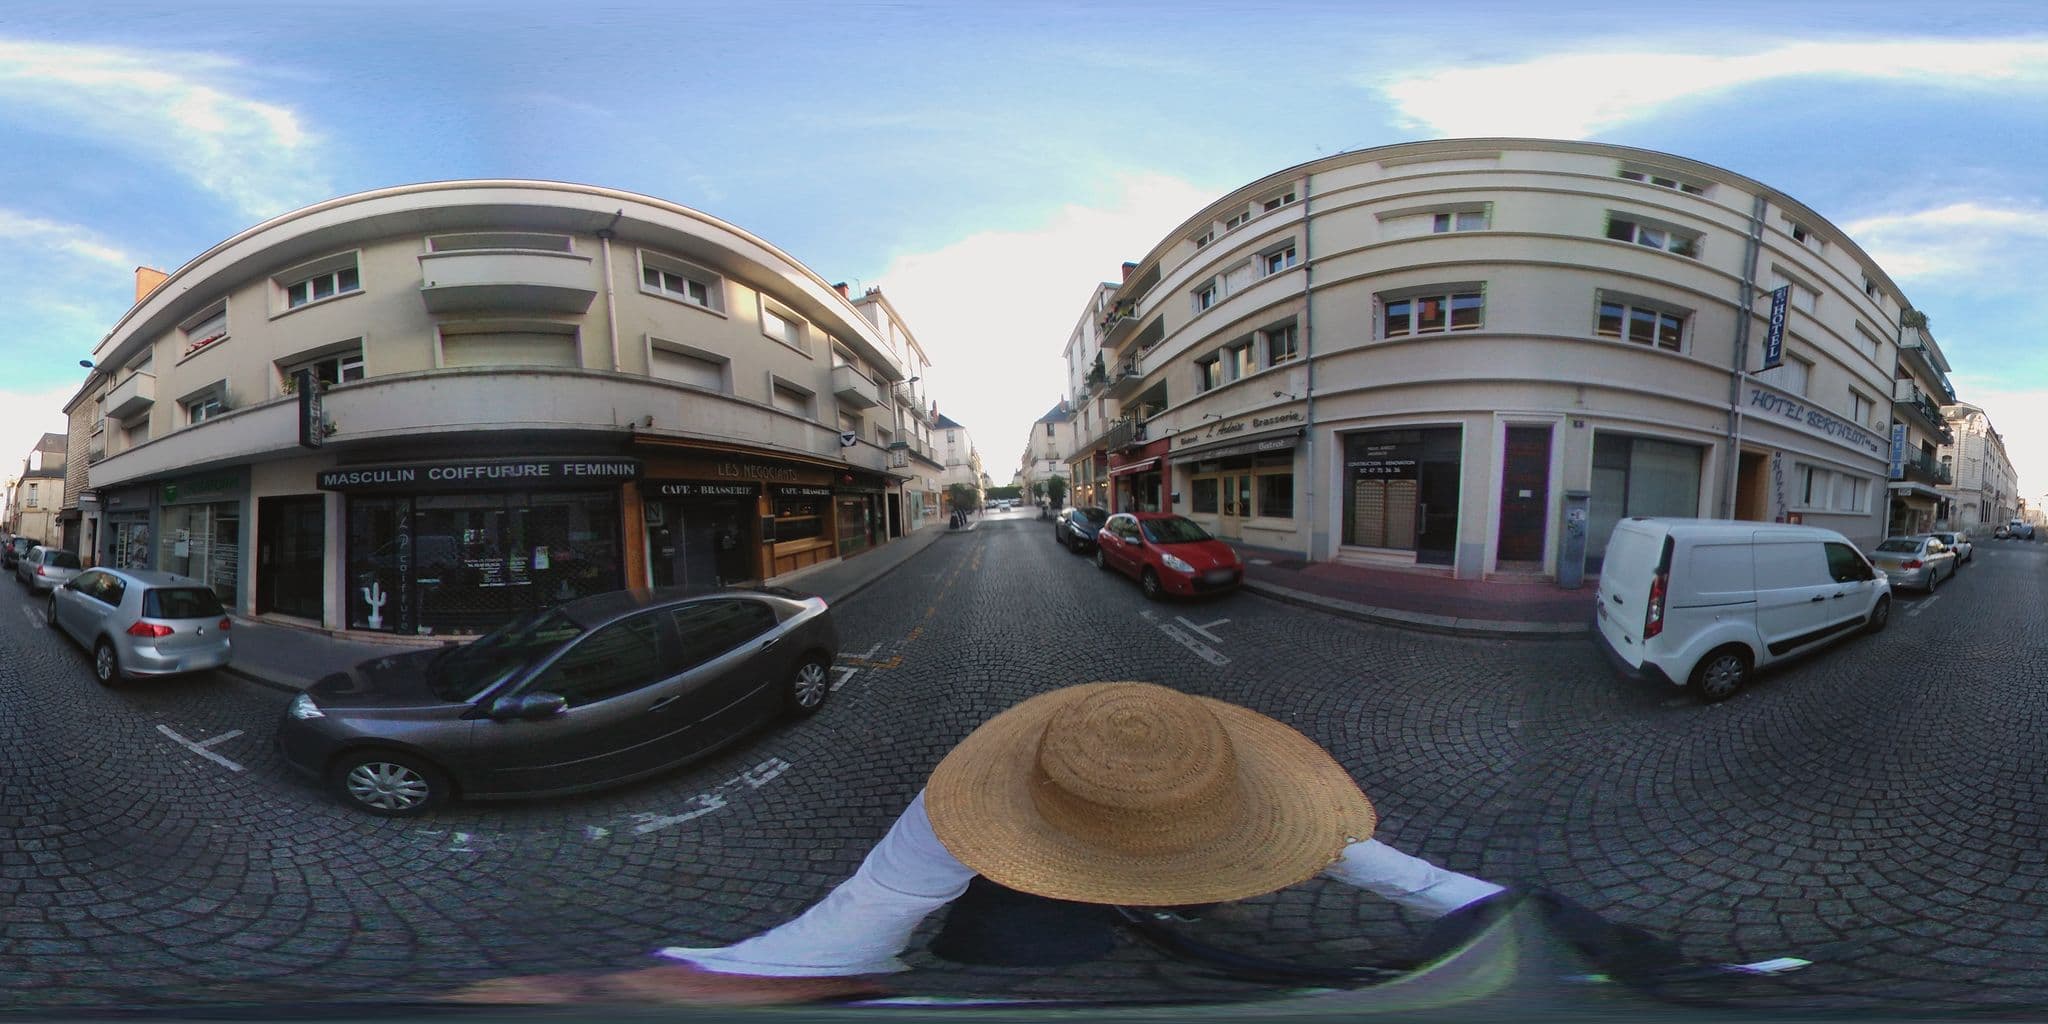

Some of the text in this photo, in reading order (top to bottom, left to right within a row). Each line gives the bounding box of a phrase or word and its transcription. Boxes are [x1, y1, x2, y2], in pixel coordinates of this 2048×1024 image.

[1769, 304, 1785, 357] HOTEL
[1253, 411, 1300, 428] Brasserie
[1751, 390, 1804, 422] HOTEL
[1807, 410, 1866, 446] BERTHELOT
[1259, 440, 1285, 450] Bistrot
[324, 469, 415, 486] MASCULIN
[563, 462, 636, 477] FEMININ
[718, 464, 739, 476] LES
[701, 486, 752, 495] BRASSERIE
